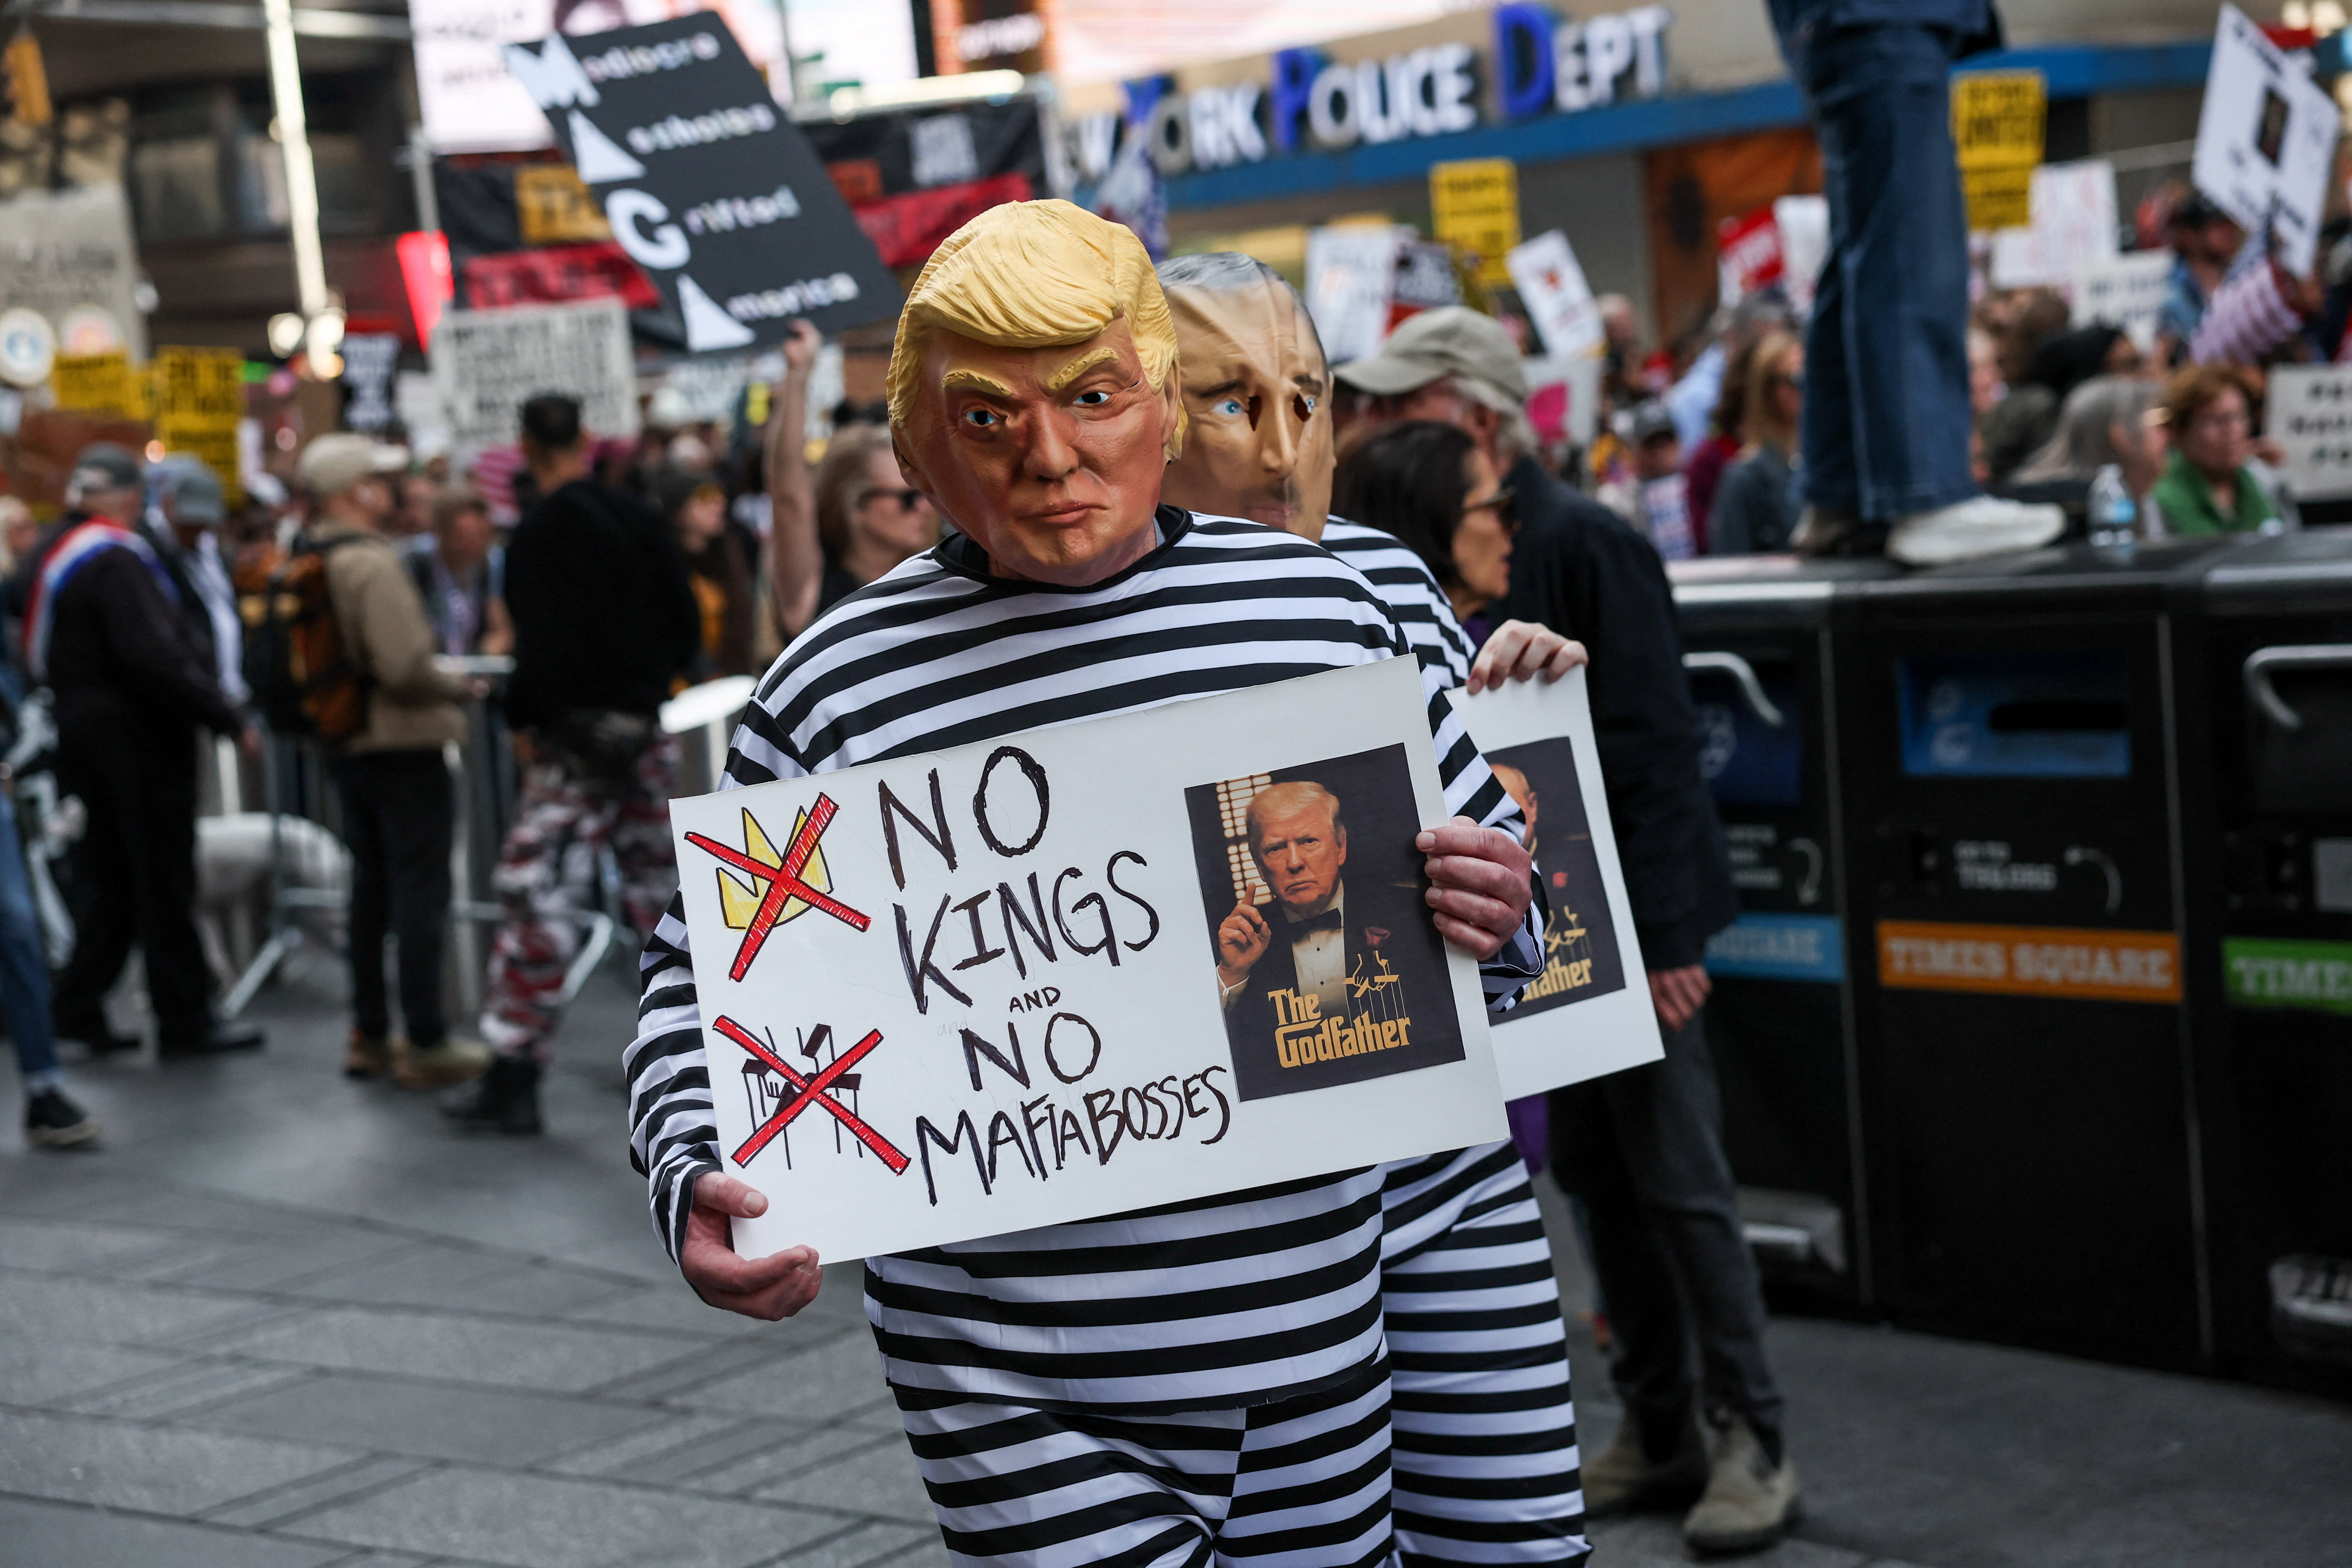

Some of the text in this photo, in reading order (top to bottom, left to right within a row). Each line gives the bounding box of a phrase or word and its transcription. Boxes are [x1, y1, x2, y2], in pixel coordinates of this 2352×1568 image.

[1268, 44, 1477, 151] POLICE
[1495, 1, 1670, 117] DEPT
[878, 746, 1050, 892] NO
[892, 850, 1160, 1015] KINGS
[1885, 936, 2175, 989] TIMES SQUARE
[1009, 986, 1061, 1013] AND
[1268, 987, 1321, 1026] The
[958, 1012, 1102, 1092] NO
[1274, 1010, 1411, 1069] Godfather
